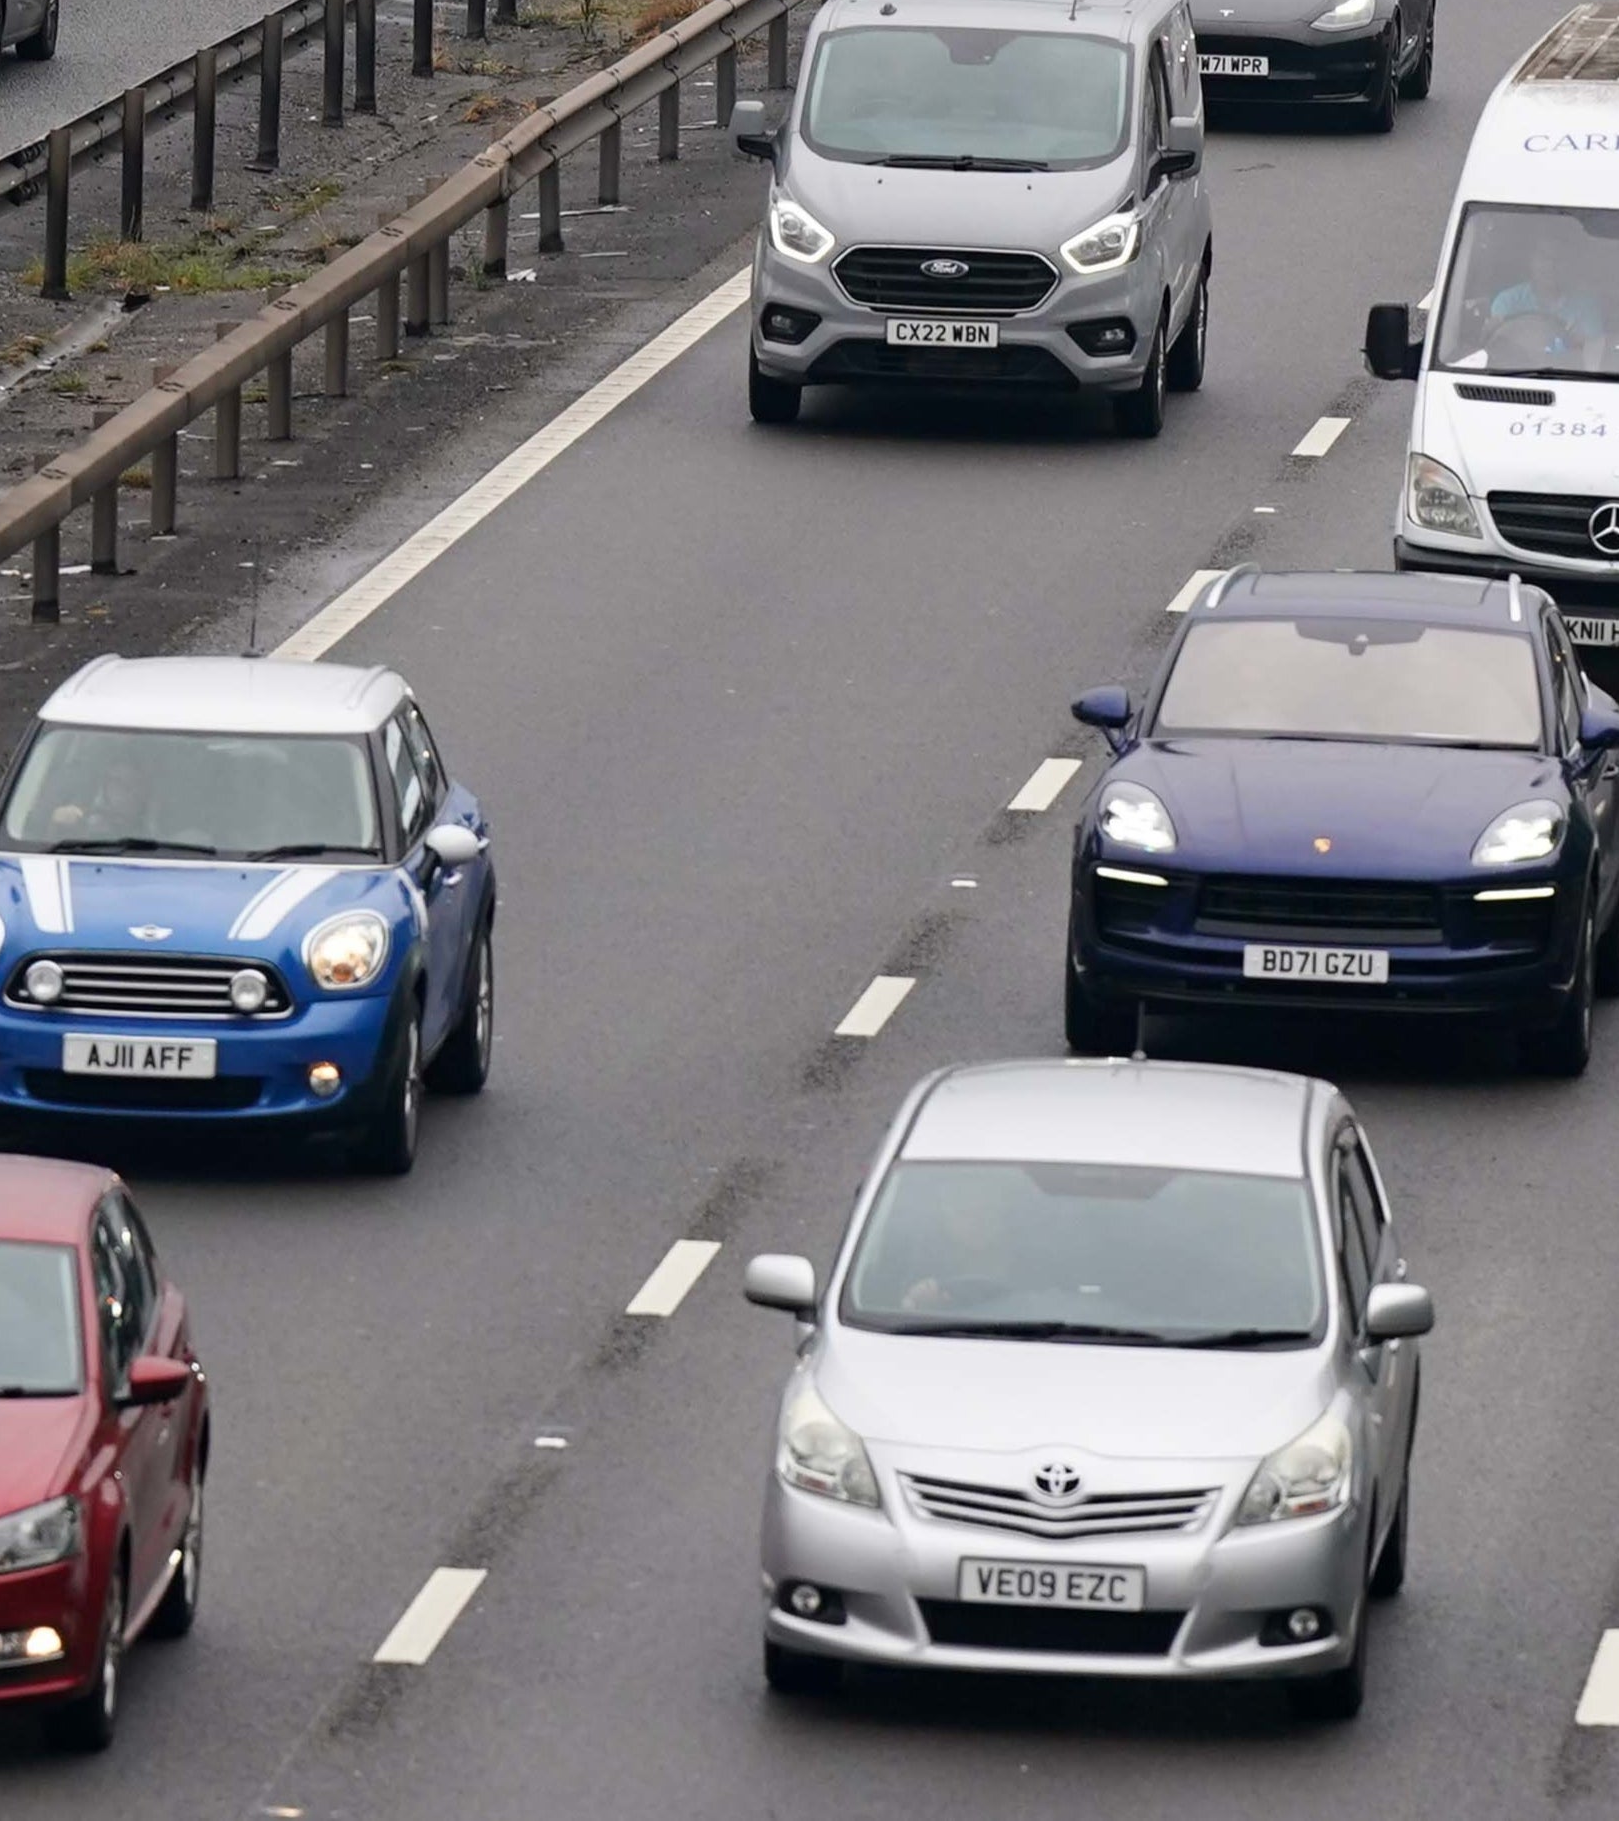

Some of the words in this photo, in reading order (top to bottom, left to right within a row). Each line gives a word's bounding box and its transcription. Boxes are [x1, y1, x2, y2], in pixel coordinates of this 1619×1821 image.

[1197, 56, 1230, 75] W71
[1232, 58, 1264, 76] WPR
[895, 321, 946, 344] CX22
[951, 324, 990, 345] WBN
[1509, 421, 1608, 438] 01384
[1566, 619, 1604, 641] KN11
[1263, 948, 1317, 975] BD71
[1324, 951, 1374, 977] GZU
[87, 1044, 135, 1069] AJ11
[142, 1045, 194, 1071] AFF
[976, 1568, 1057, 1600] VE09
[1065, 1572, 1128, 1605] EZC
